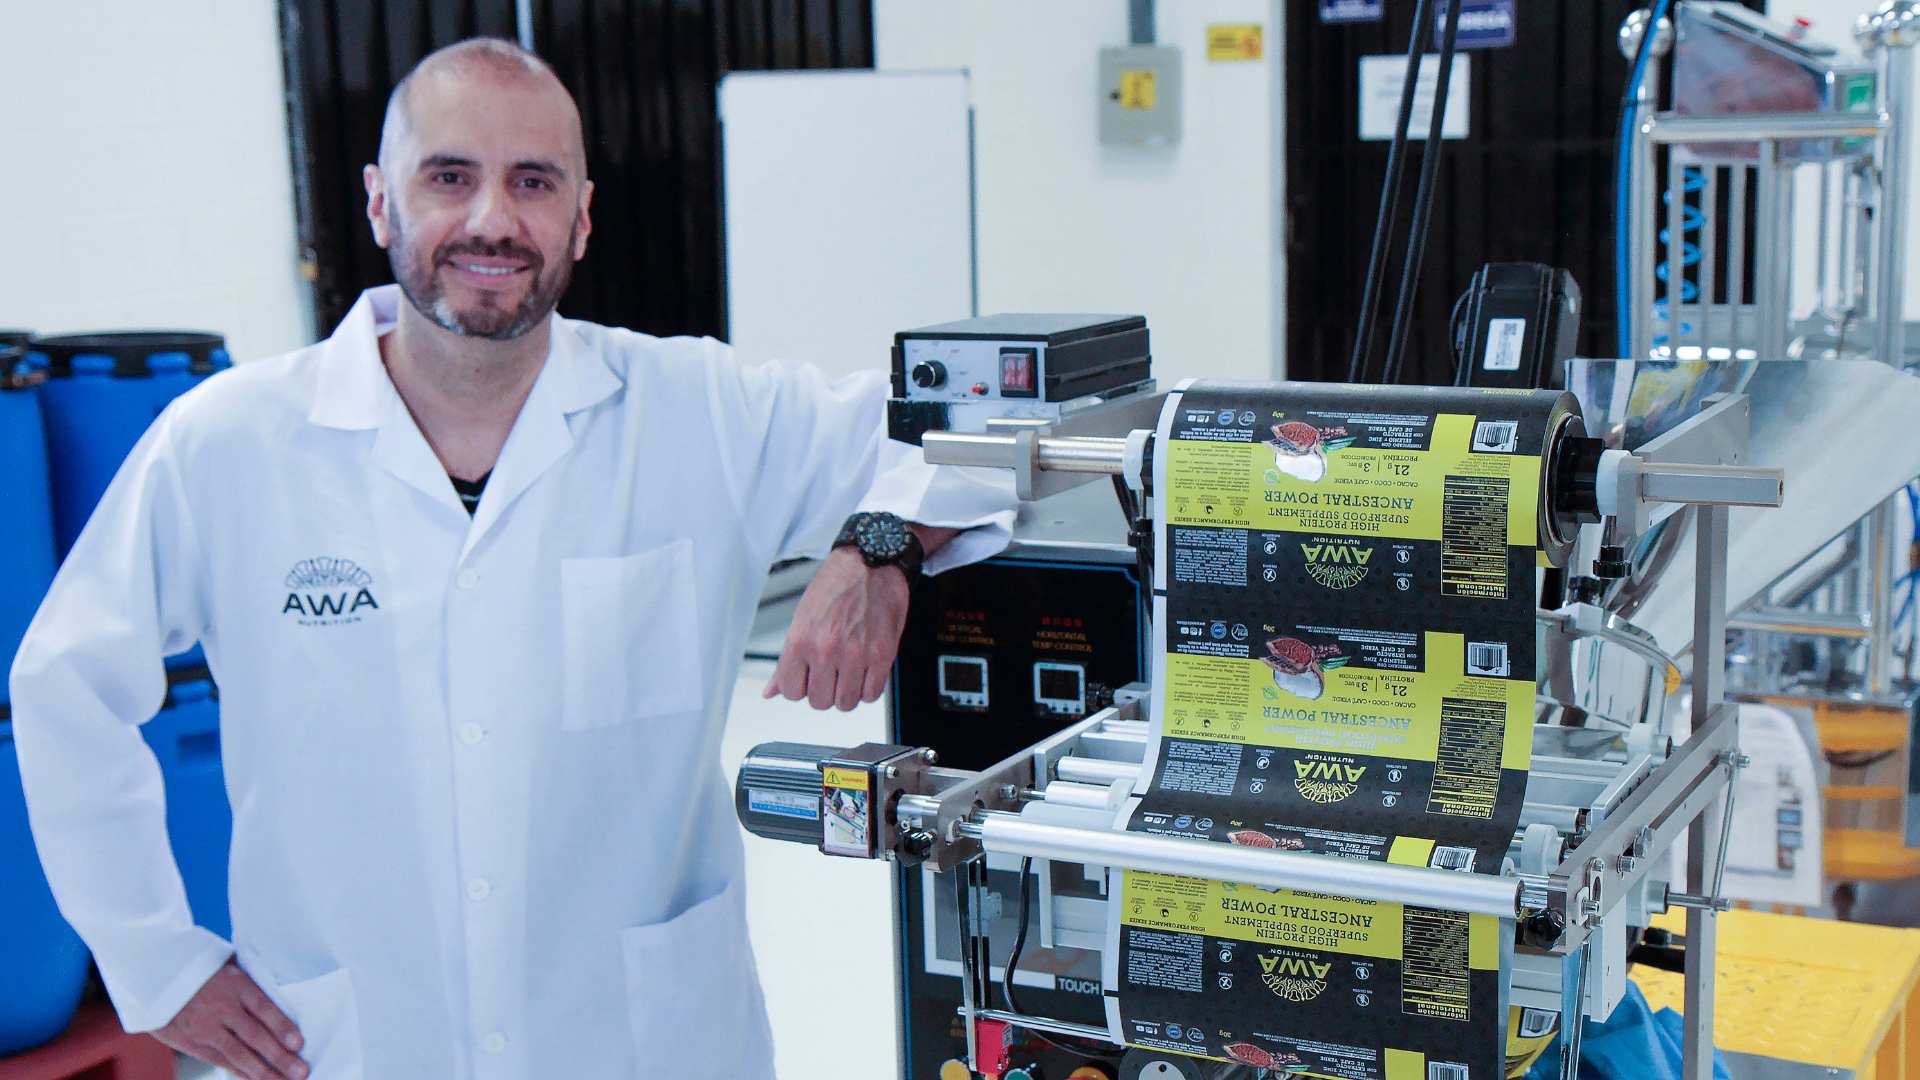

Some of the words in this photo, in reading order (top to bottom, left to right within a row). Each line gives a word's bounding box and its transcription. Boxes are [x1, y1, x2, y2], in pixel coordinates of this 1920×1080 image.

[1382, 454, 1418, 462] PROTEÍNA
[1264, 490, 1318, 504] POWER
[1323, 493, 1414, 510] ANCESTRAL
[1268, 508, 1339, 519] SUPPLEMENT
[1343, 511, 1409, 523] SUPERFOOD
[1300, 519, 1347, 528] PROTEIN
[1351, 522, 1379, 531] HIGH
[1301, 543, 1373, 565] AWA
[1457, 584, 1504, 592] Nutricional
[282, 587, 379, 616] AWA
[1380, 675, 1415, 683] PROTEÍNA
[1262, 706, 1316, 722] POWER
[1320, 711, 1411, 731] ANCESTRAL
[1308, 754, 1354, 763] NUTRITION
[1294, 760, 1366, 782] AWA
[1442, 804, 1490, 812] Nutricional
[1442, 808, 1490, 818] Información
[1292, 890, 1312, 898] VERDE
[1332, 895, 1350, 903] COCO
[1220, 897, 1276, 916] POWER
[1355, 898, 1377, 906] CACAO
[1280, 905, 1373, 928] ANCESTRAL
[1149, 920, 1189, 930] PERFORMANCE
[1224, 915, 1296, 932] SUPPLEMENT
[1256, 929, 1305, 943] PROTEIN
[1300, 925, 1368, 941] SUPERFOOD
[1308, 935, 1338, 947] HIGH
[1257, 954, 1332, 979] AWA
[1058, 978, 1099, 995] TOUCH
[1417, 1003, 1466, 1014] Nutricional
[1417, 1009, 1466, 1020] Información
[1336, 1063, 1366, 1071] EXTRACTO
